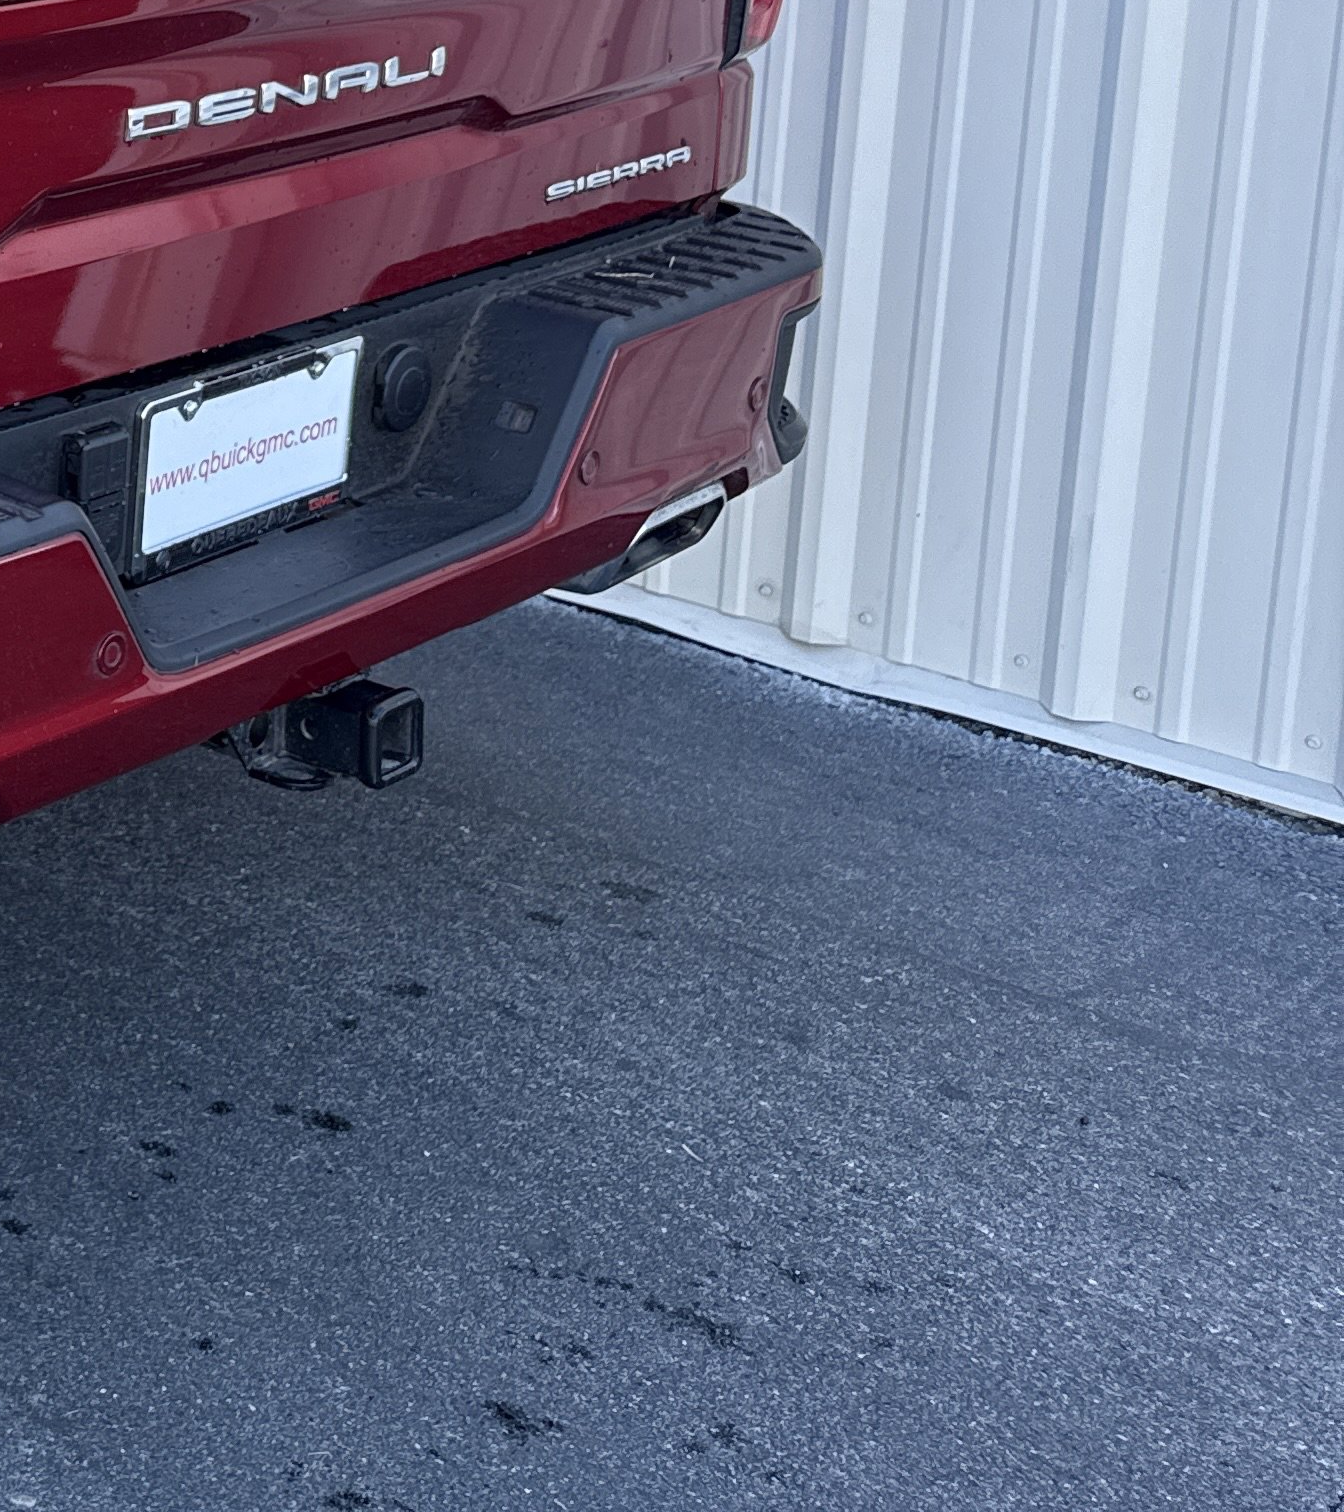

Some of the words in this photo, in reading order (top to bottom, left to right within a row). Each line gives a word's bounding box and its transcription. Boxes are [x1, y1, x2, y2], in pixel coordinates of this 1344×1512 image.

[126, 46, 446, 141] DENALI
[545, 144, 691, 202] SIERRA
[149, 415, 338, 495] www.qbuickgmc.com
[308, 490, 340, 511] GMC
